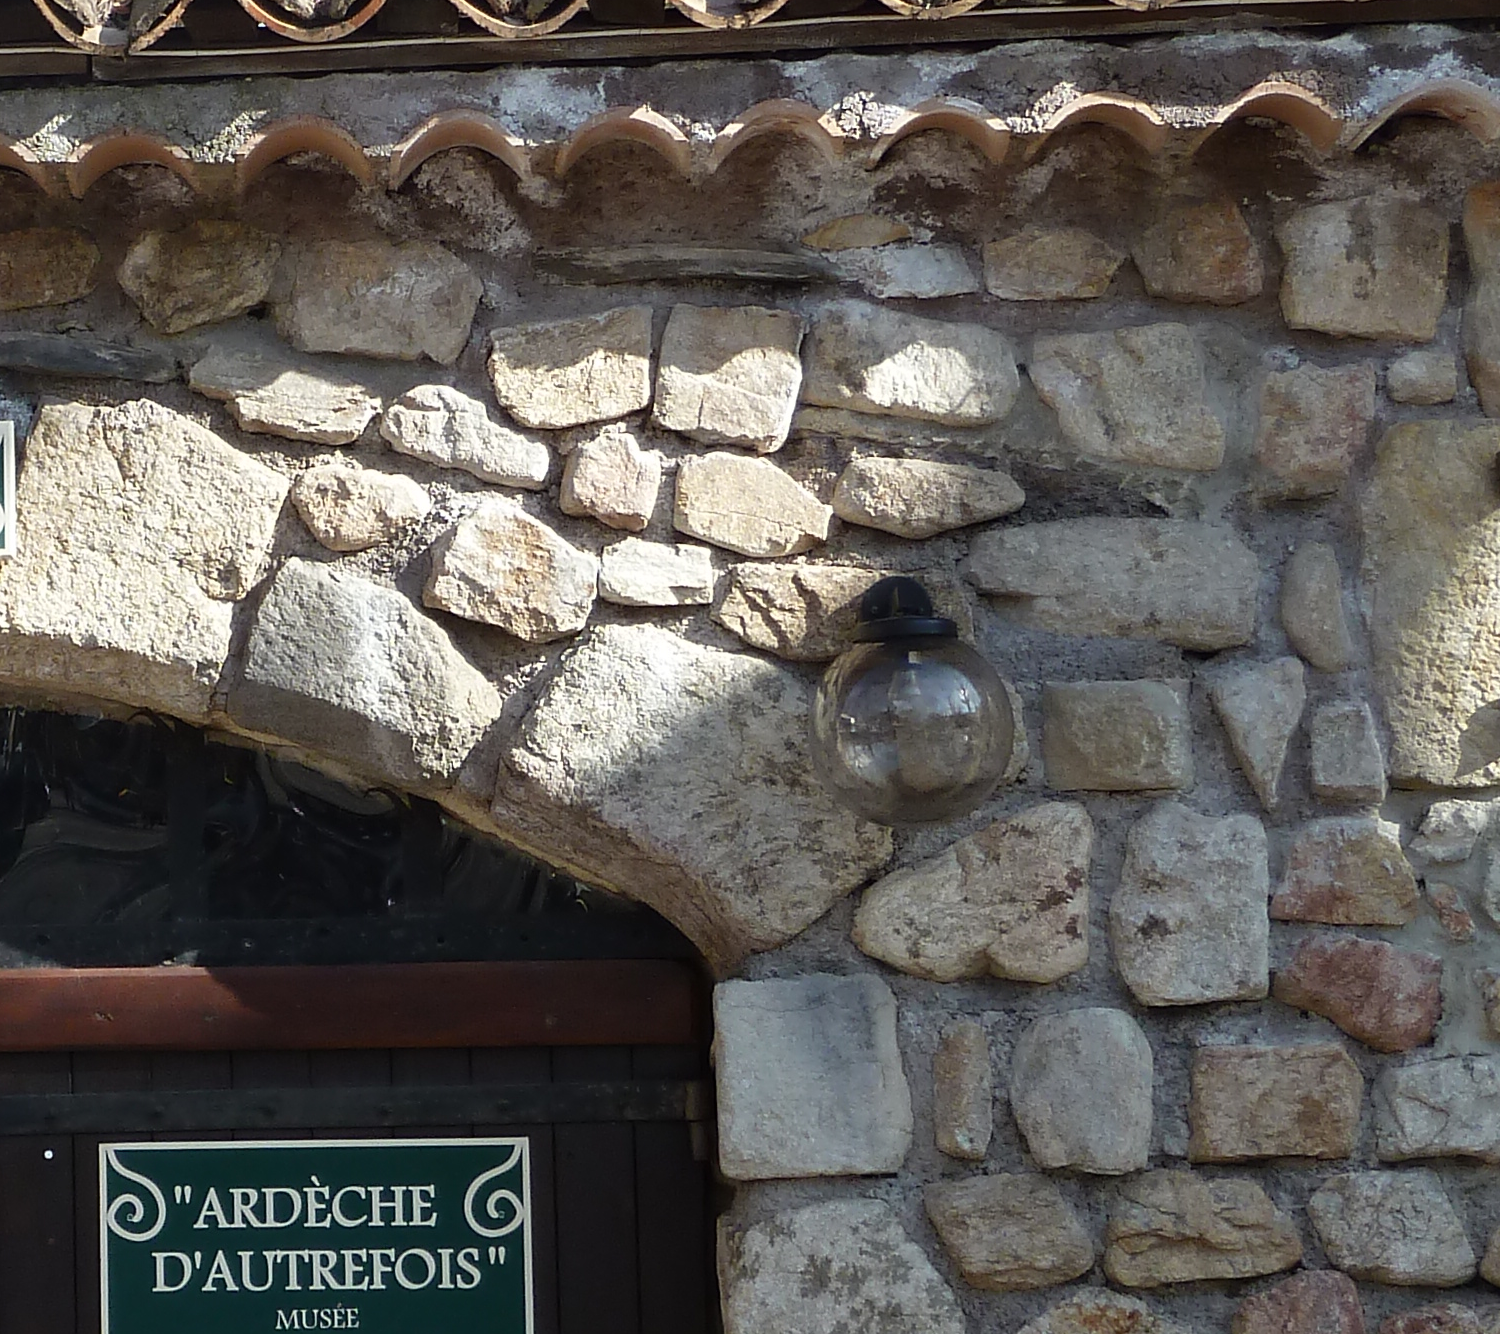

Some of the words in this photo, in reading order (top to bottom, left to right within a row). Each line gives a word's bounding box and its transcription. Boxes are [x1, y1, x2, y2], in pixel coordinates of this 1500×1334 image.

[174, 1175, 438, 1230] "ARDÈCHE
[152, 1246, 506, 1293] D'AUTREFOIS"
[275, 1303, 360, 1330] MUSÉE
